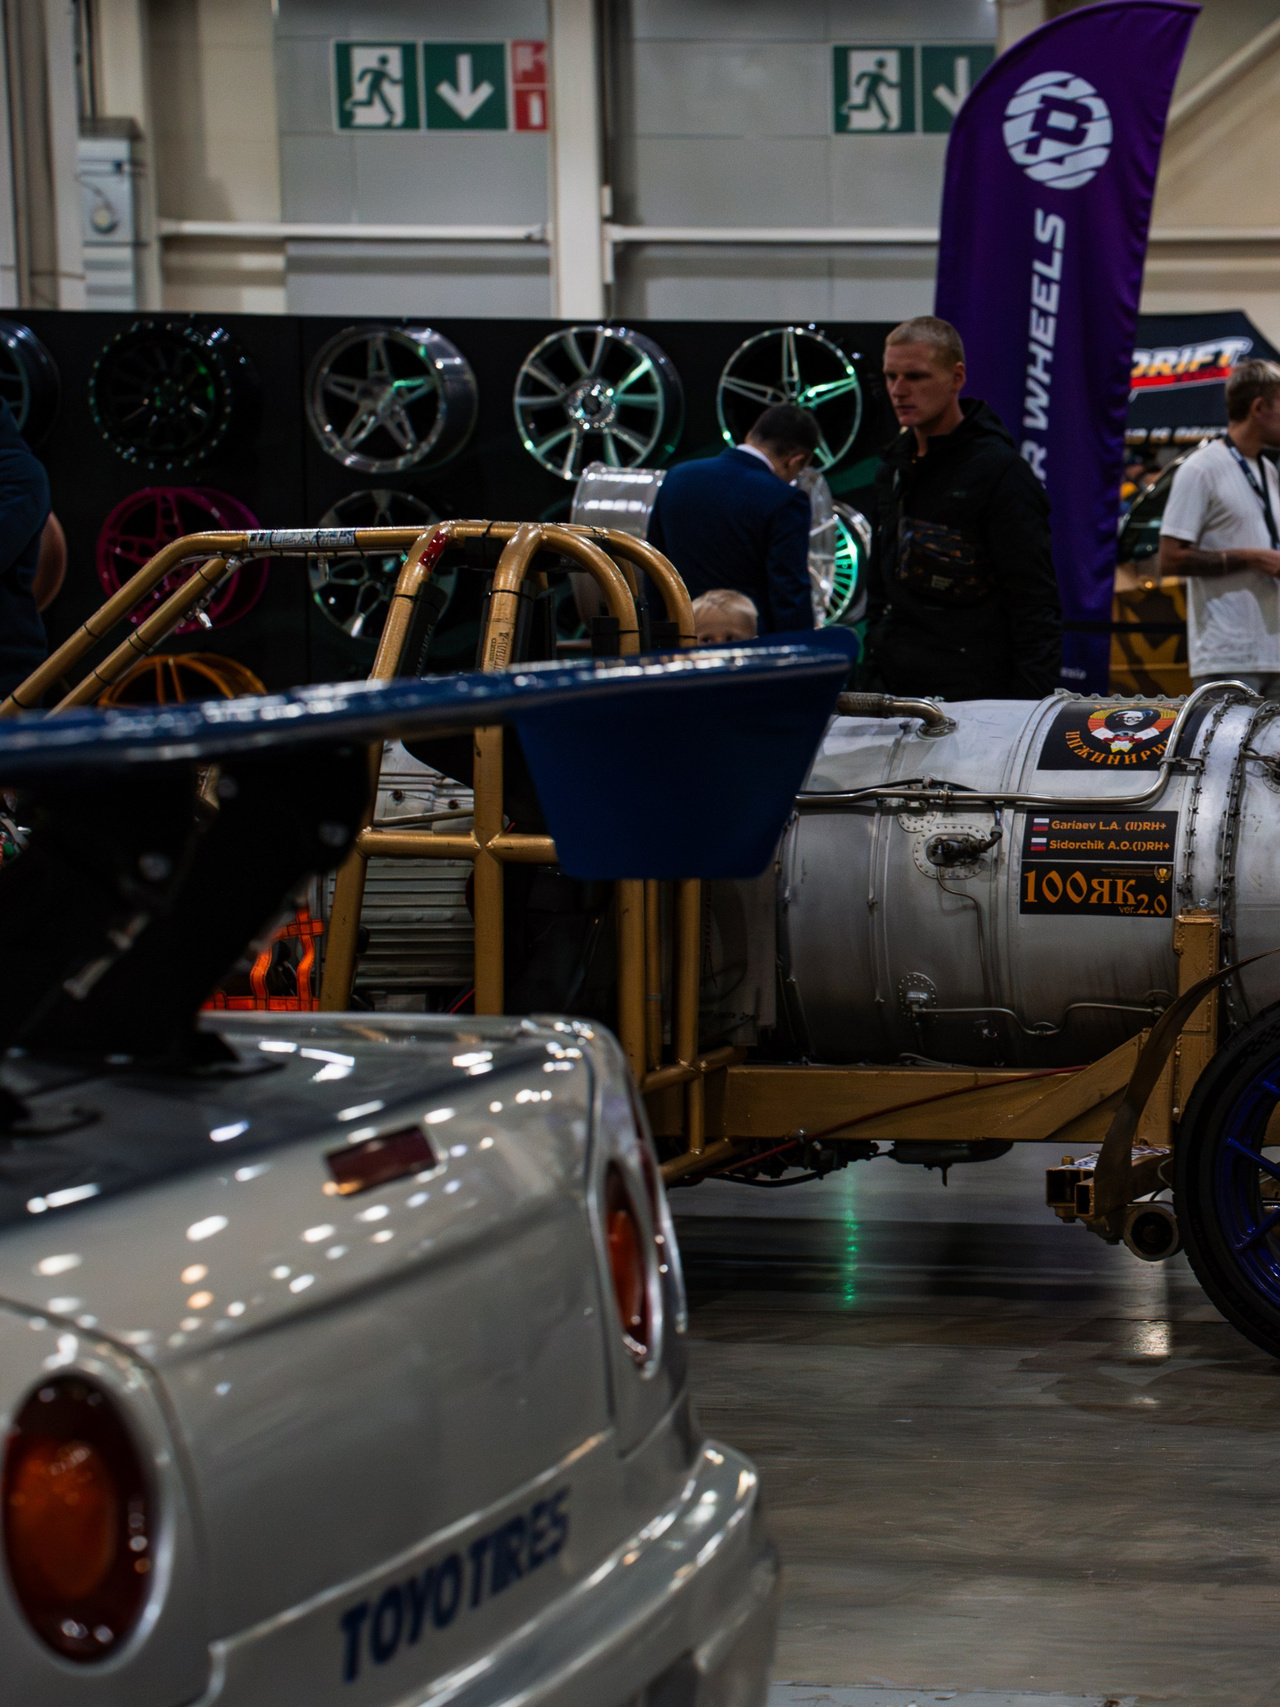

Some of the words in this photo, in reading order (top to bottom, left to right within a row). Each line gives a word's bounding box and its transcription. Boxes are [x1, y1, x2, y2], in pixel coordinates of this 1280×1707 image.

[1022, 208, 1066, 430] WHEELS
[1065, 730, 1170, 765] ИНЖИНИРИ
[1051, 820, 1096, 830] Gariaev
[1100, 821, 1121, 830] L.A.
[1049, 840, 1104, 849] Sidorchik
[1023, 870, 1137, 905] 100ЯК
[340, 1552, 462, 1683] TOYO
[469, 1484, 571, 1609] TIRES
